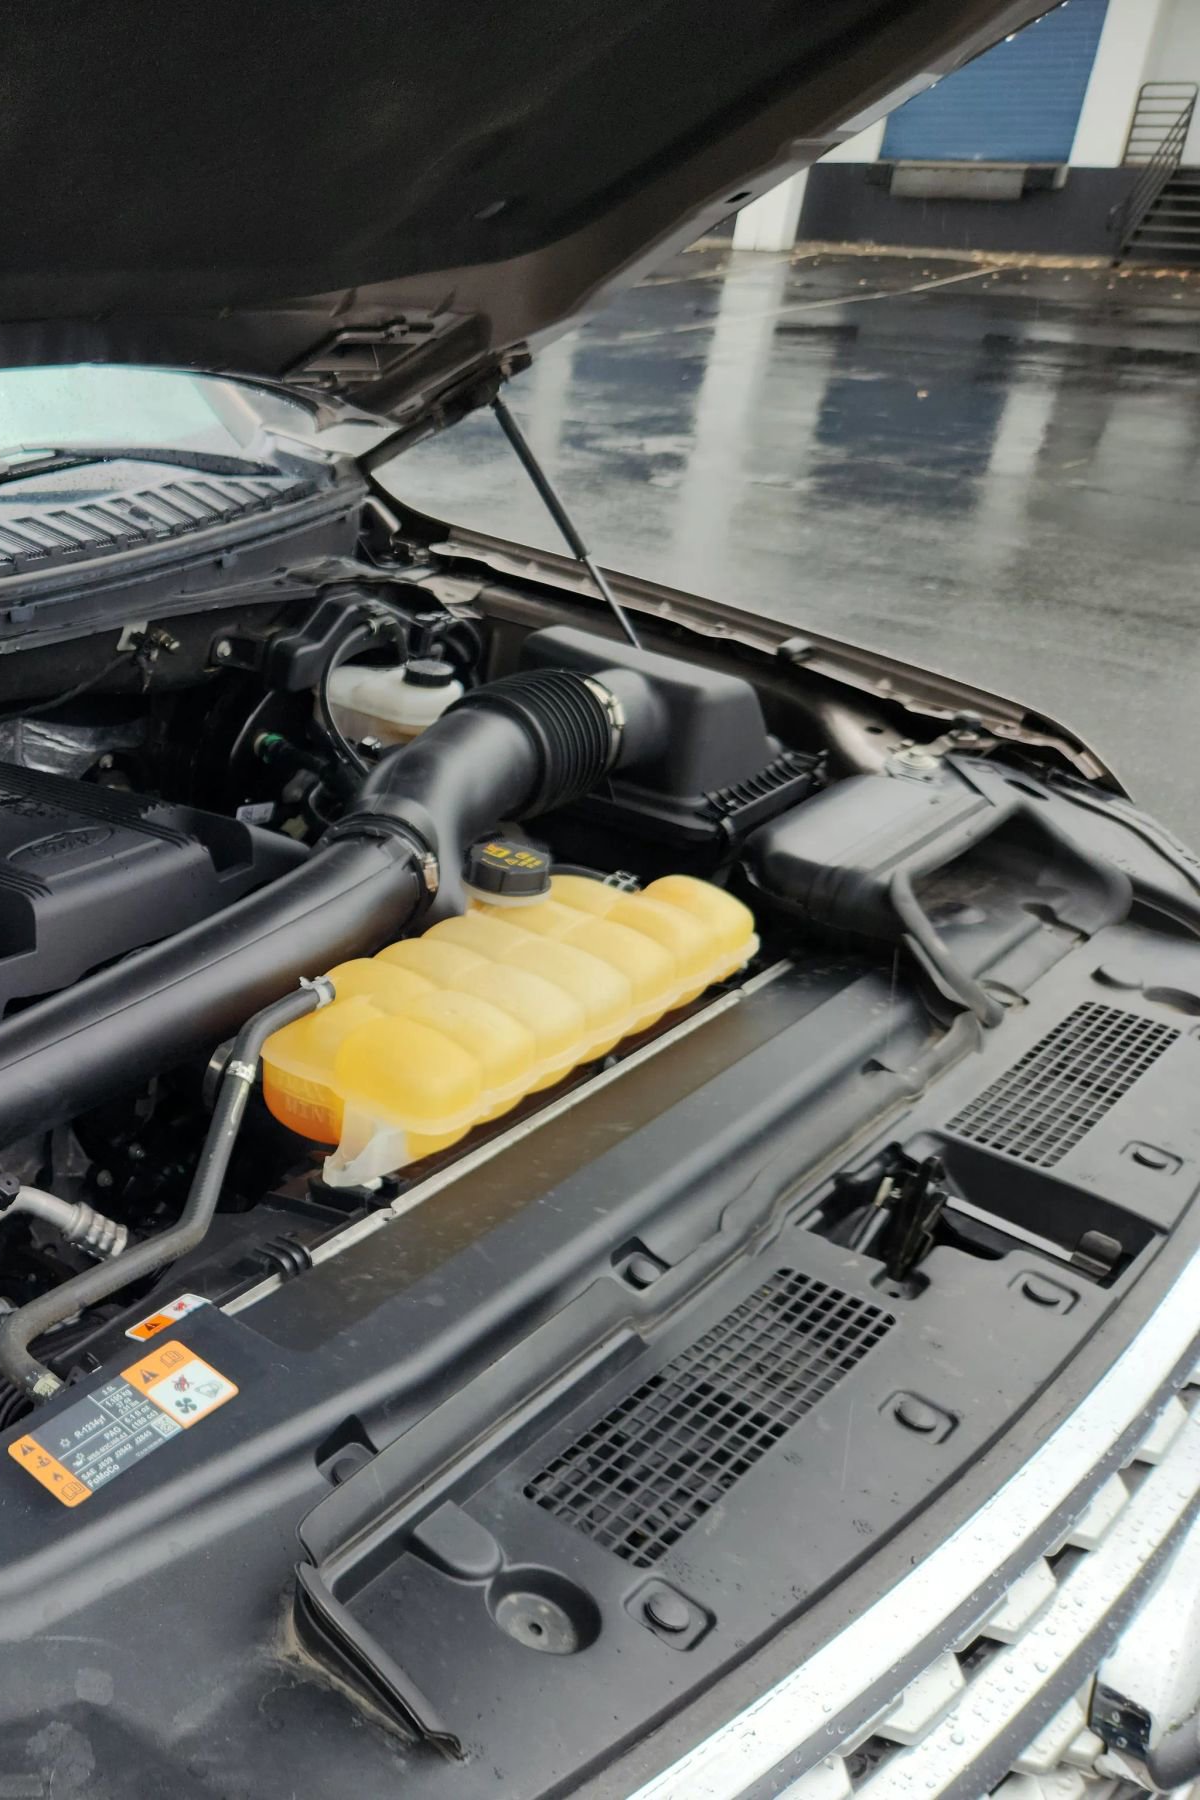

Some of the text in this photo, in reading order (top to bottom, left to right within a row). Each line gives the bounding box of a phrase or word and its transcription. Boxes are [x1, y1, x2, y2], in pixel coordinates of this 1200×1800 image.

[72, 1414, 106, 1438] R-1234yf
[103, 1426, 121, 1439] PAG
[80, 1468, 96, 1479] SAE
[87, 1463, 120, 1487] FoMoCo
